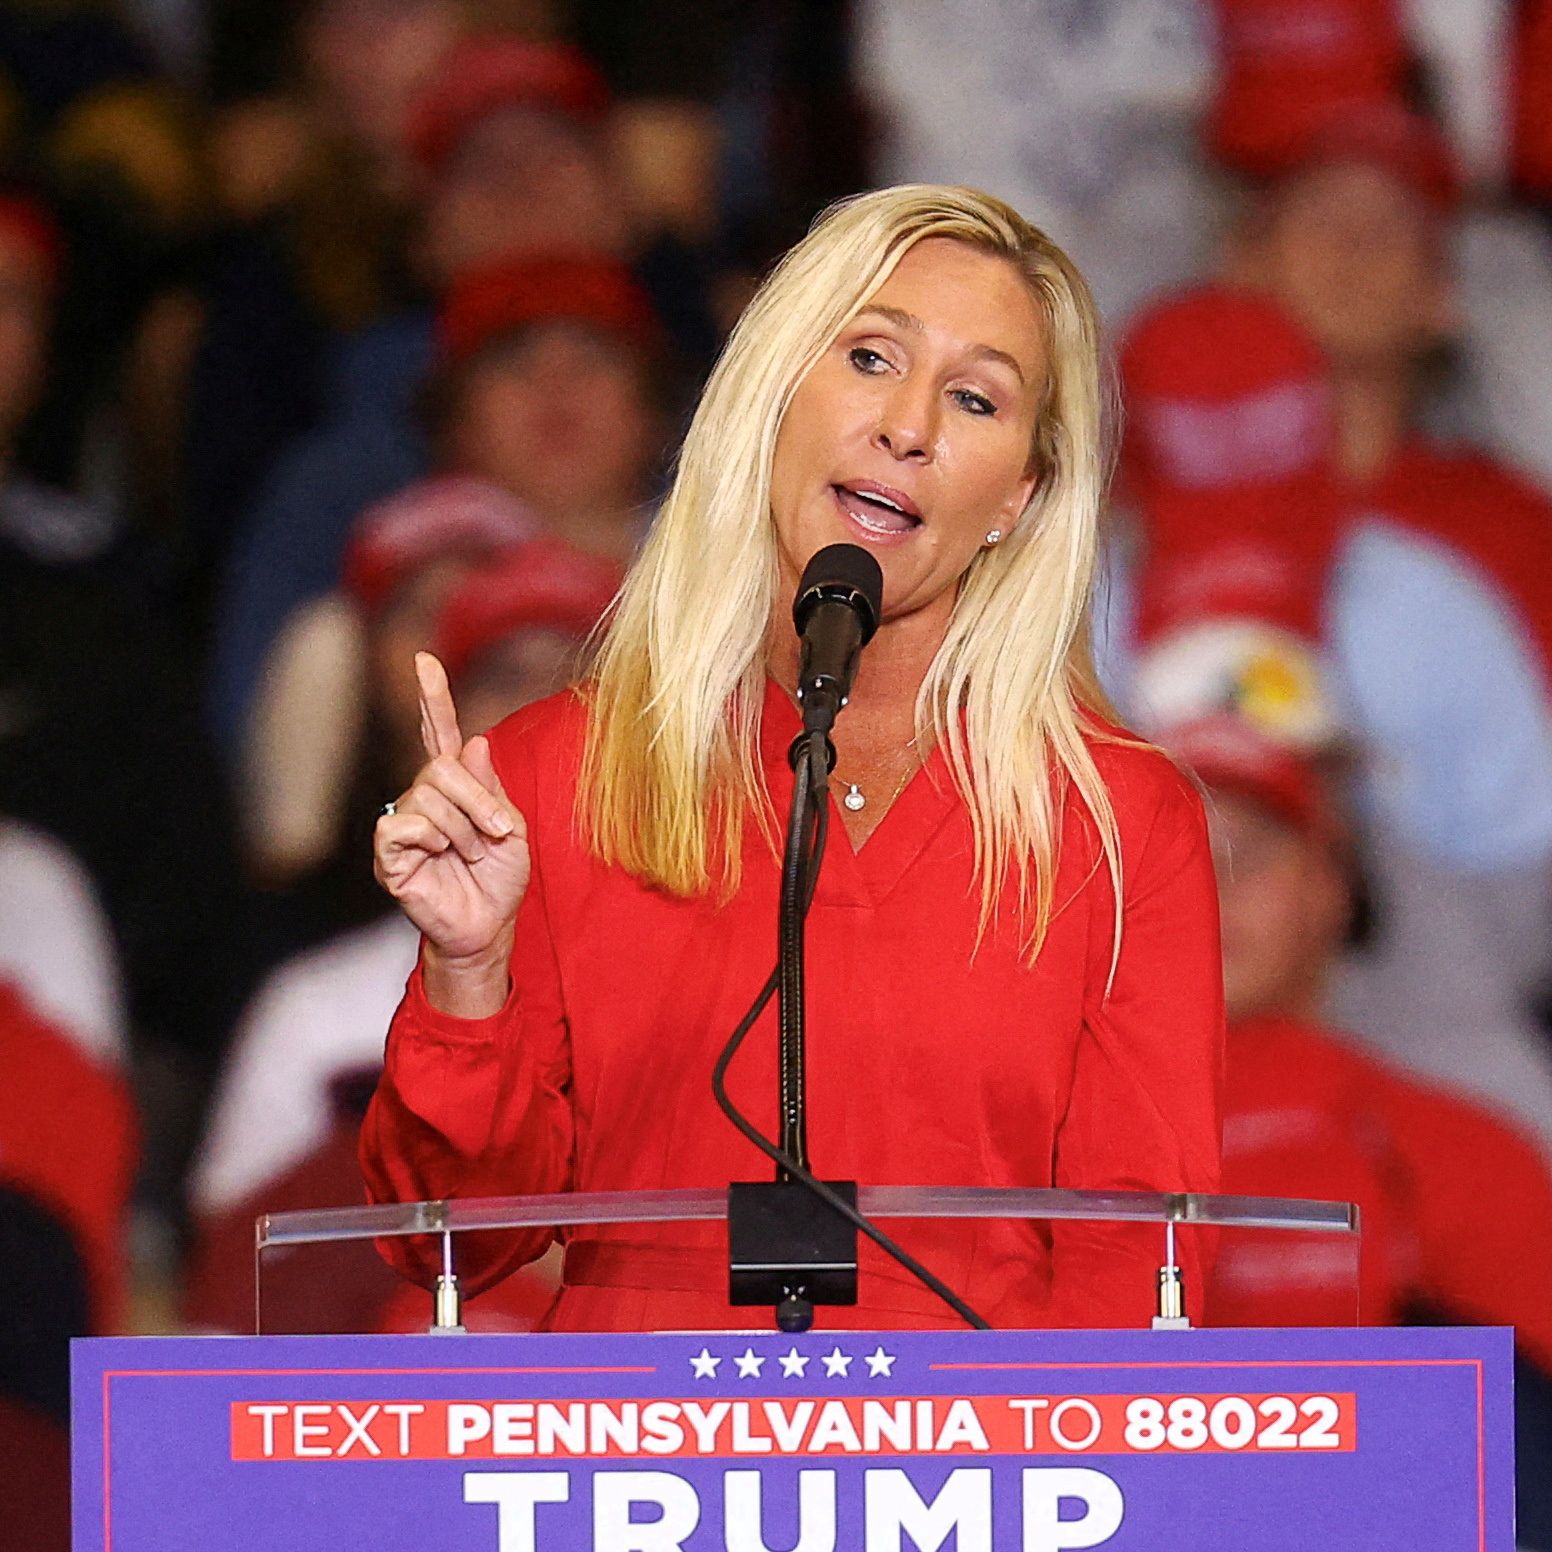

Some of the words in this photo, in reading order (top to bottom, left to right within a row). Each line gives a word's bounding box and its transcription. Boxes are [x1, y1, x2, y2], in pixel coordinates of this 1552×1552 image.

[247, 1404, 425, 1457] TEXT
[447, 1399, 991, 1456] PENNSYLVANIA
[1008, 1397, 1102, 1451] TO
[1123, 1395, 1340, 1450] 88022
